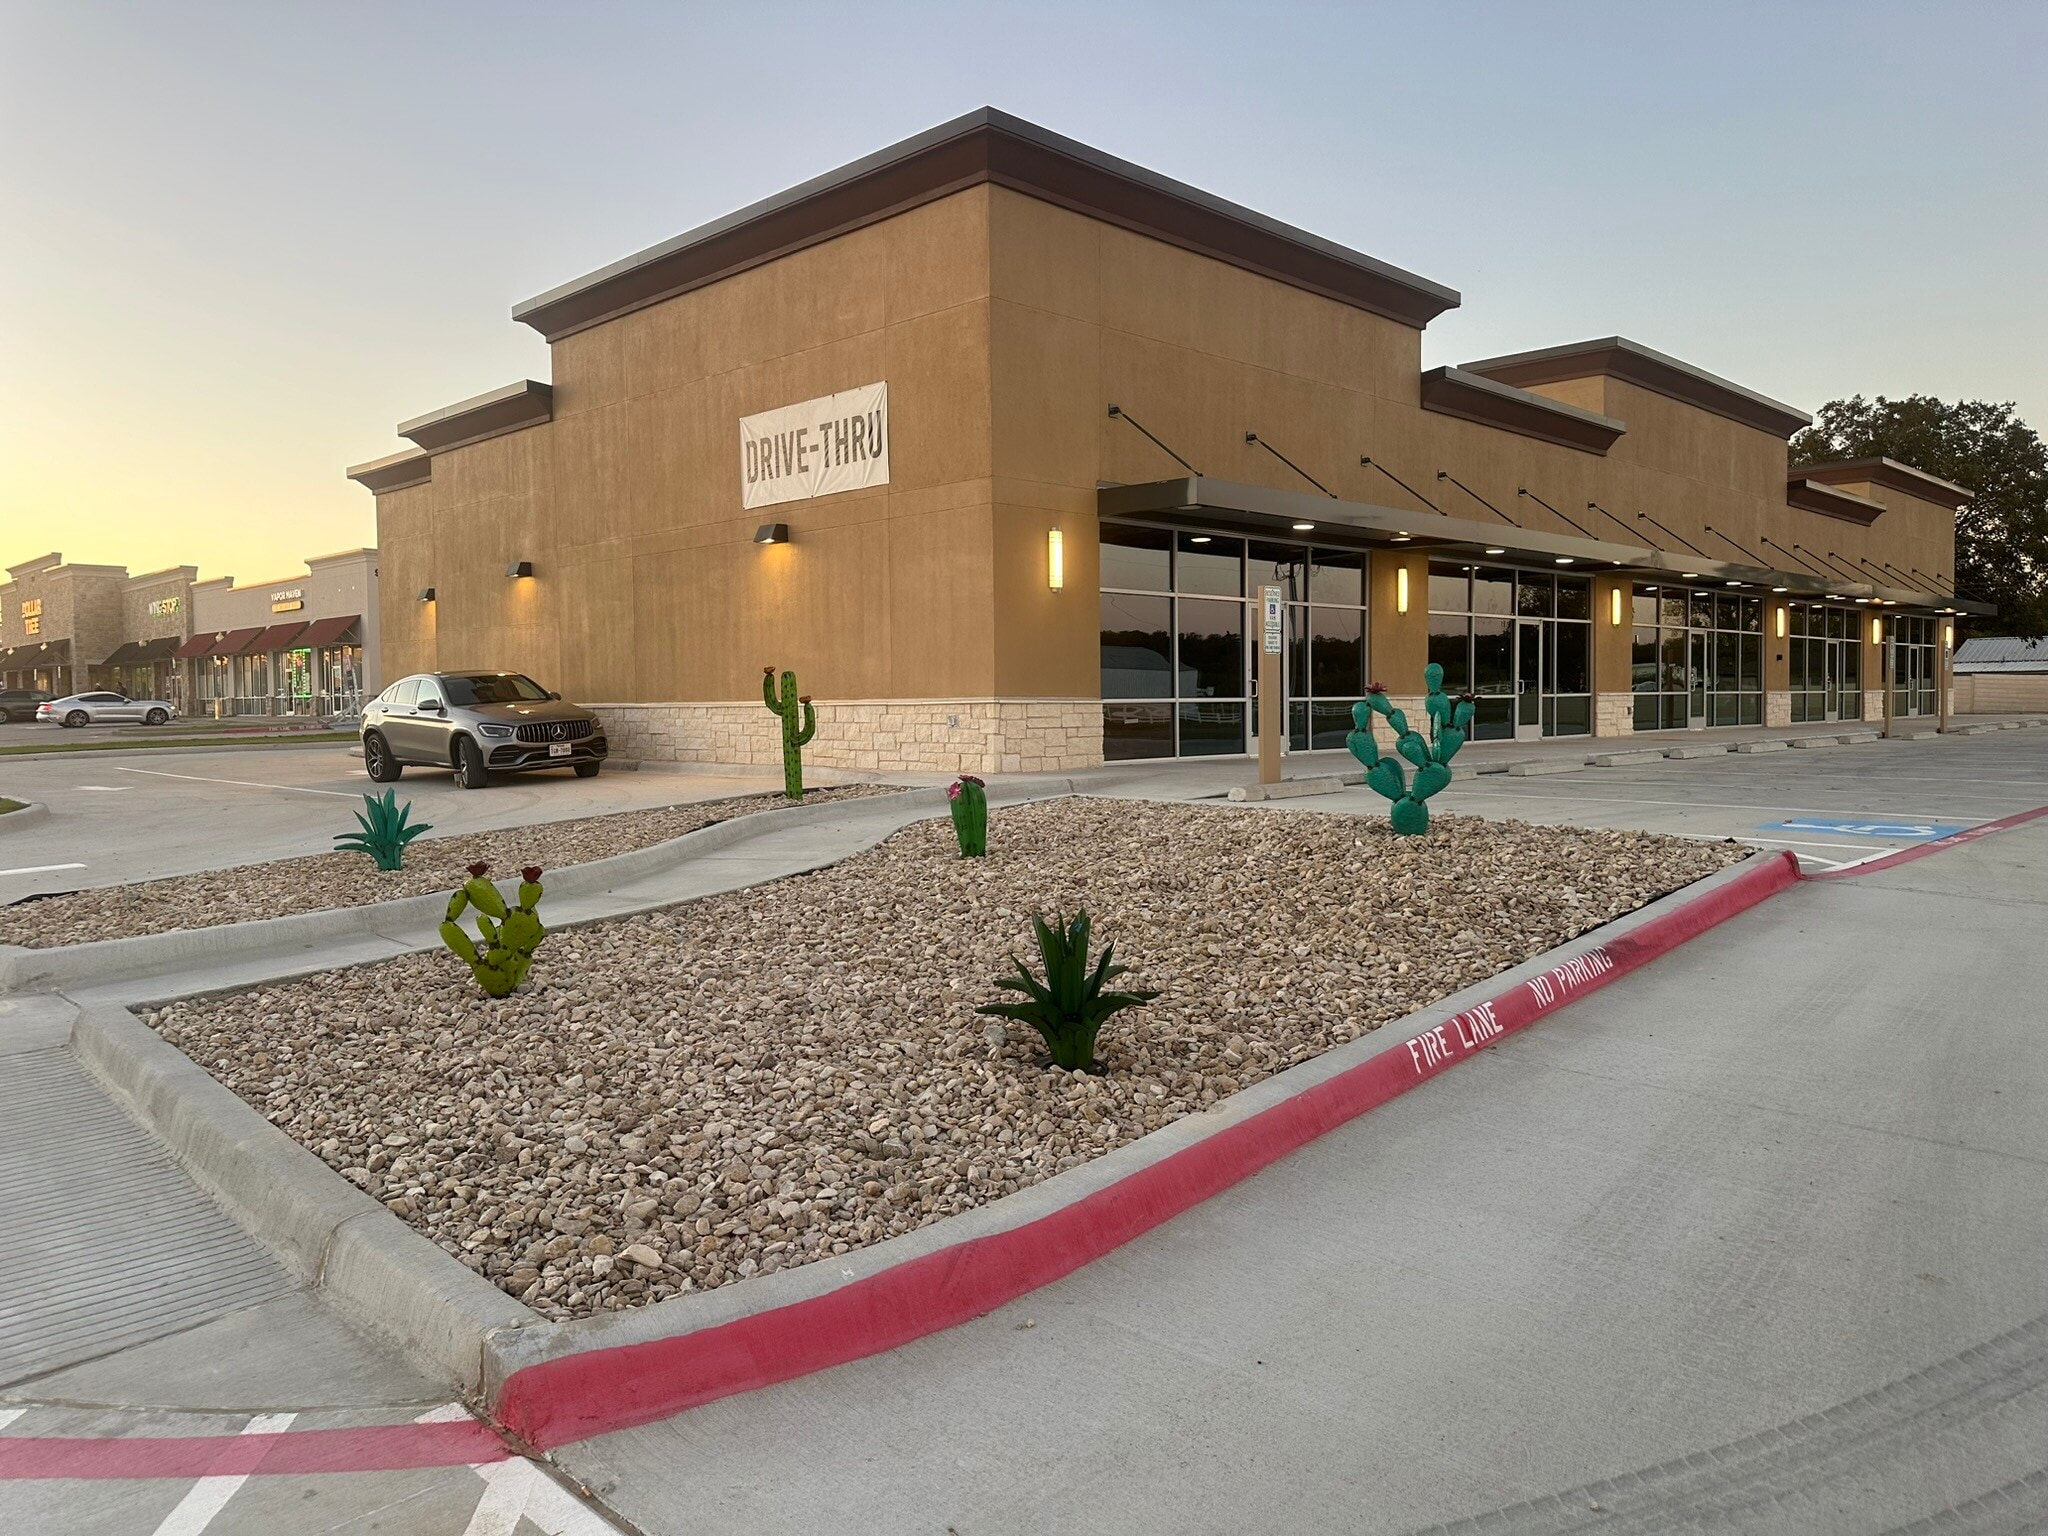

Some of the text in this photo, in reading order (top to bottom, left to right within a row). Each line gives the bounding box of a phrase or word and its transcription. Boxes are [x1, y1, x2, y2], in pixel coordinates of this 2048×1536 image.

[745, 409, 883, 484] DRIVE-THRU
[21, 598, 42, 618] DOLLAR
[24, 617, 40, 635] TREE
[1526, 946, 1614, 1009] NO PARKING
[1405, 1000, 1504, 1074] FIRE LANE
